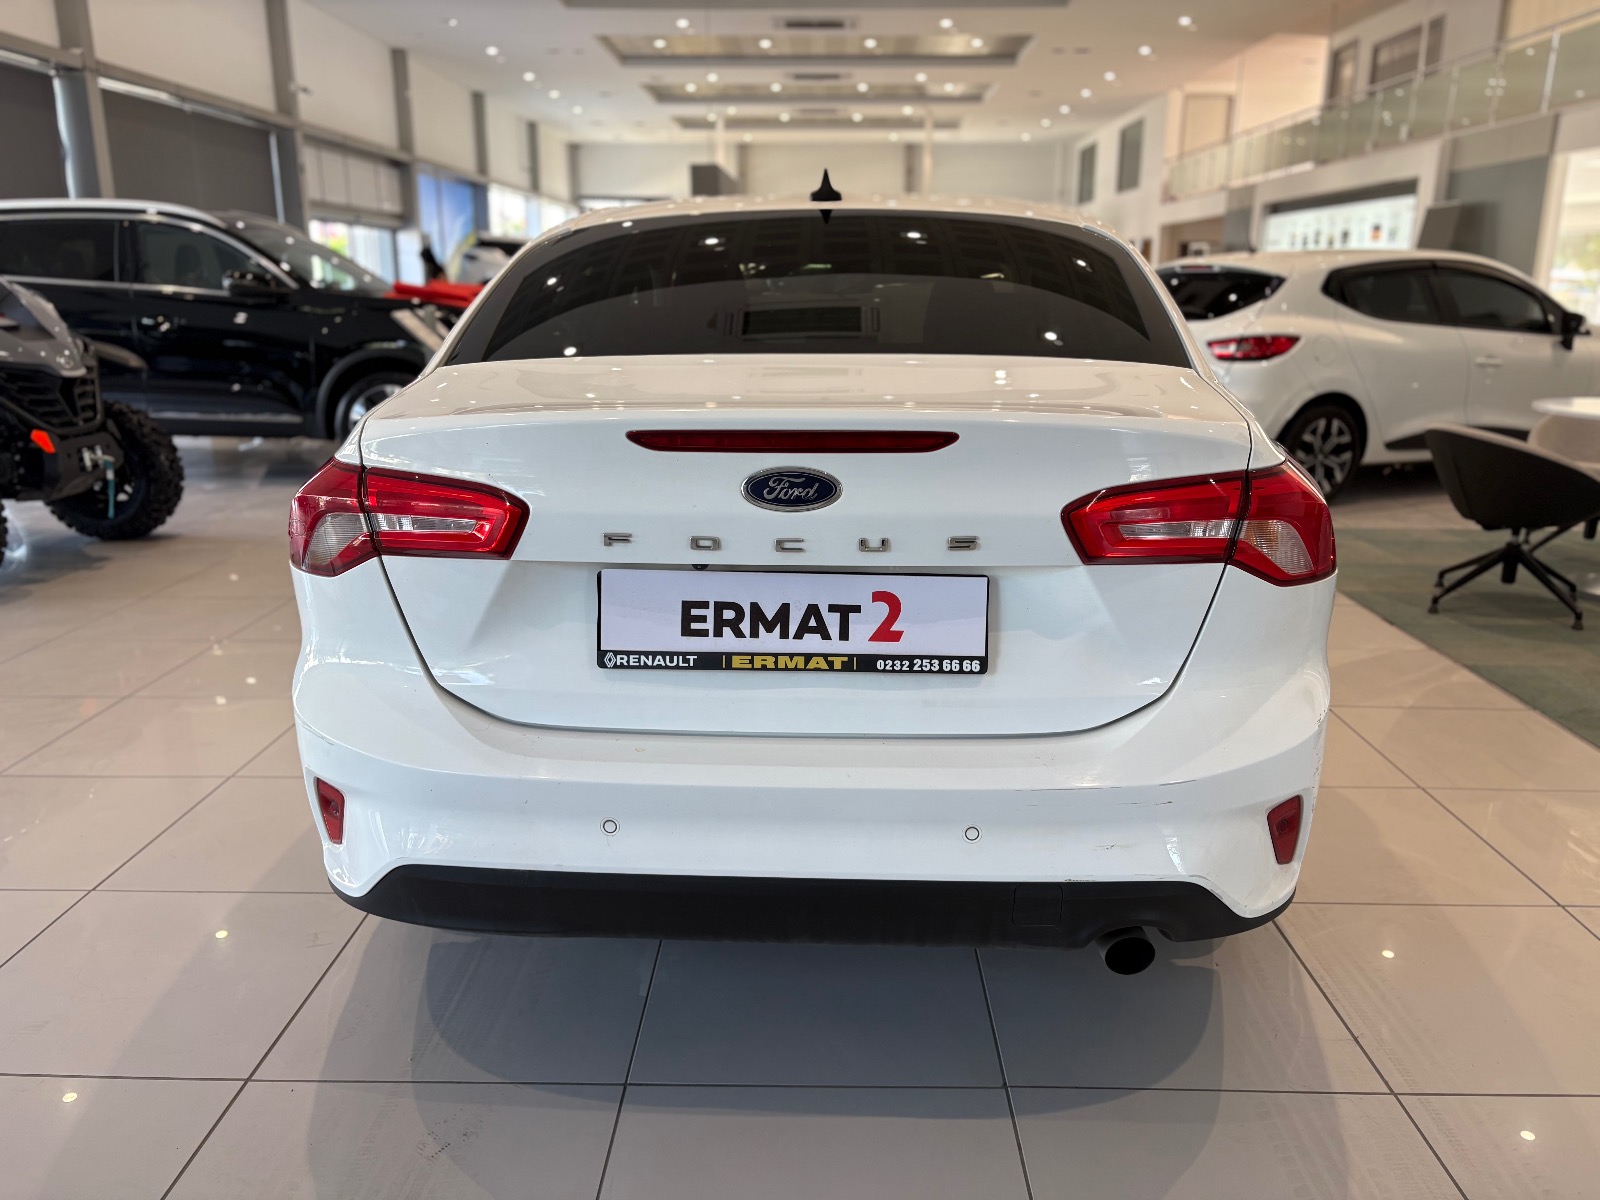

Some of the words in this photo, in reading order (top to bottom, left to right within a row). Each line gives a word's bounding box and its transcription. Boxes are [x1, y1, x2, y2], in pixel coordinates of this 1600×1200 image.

[763, 476, 818, 500] Ford
[602, 532, 980, 552] FOCUS
[680, 600, 861, 641] ERMAT
[867, 590, 904, 642] 2
[616, 654, 697, 667] RENAULT
[731, 655, 848, 670] ERMAT
[876, 659, 910, 671] 0232
[913, 659, 940, 671] 253
[942, 659, 961, 672] 66
[962, 659, 981, 673] 66
